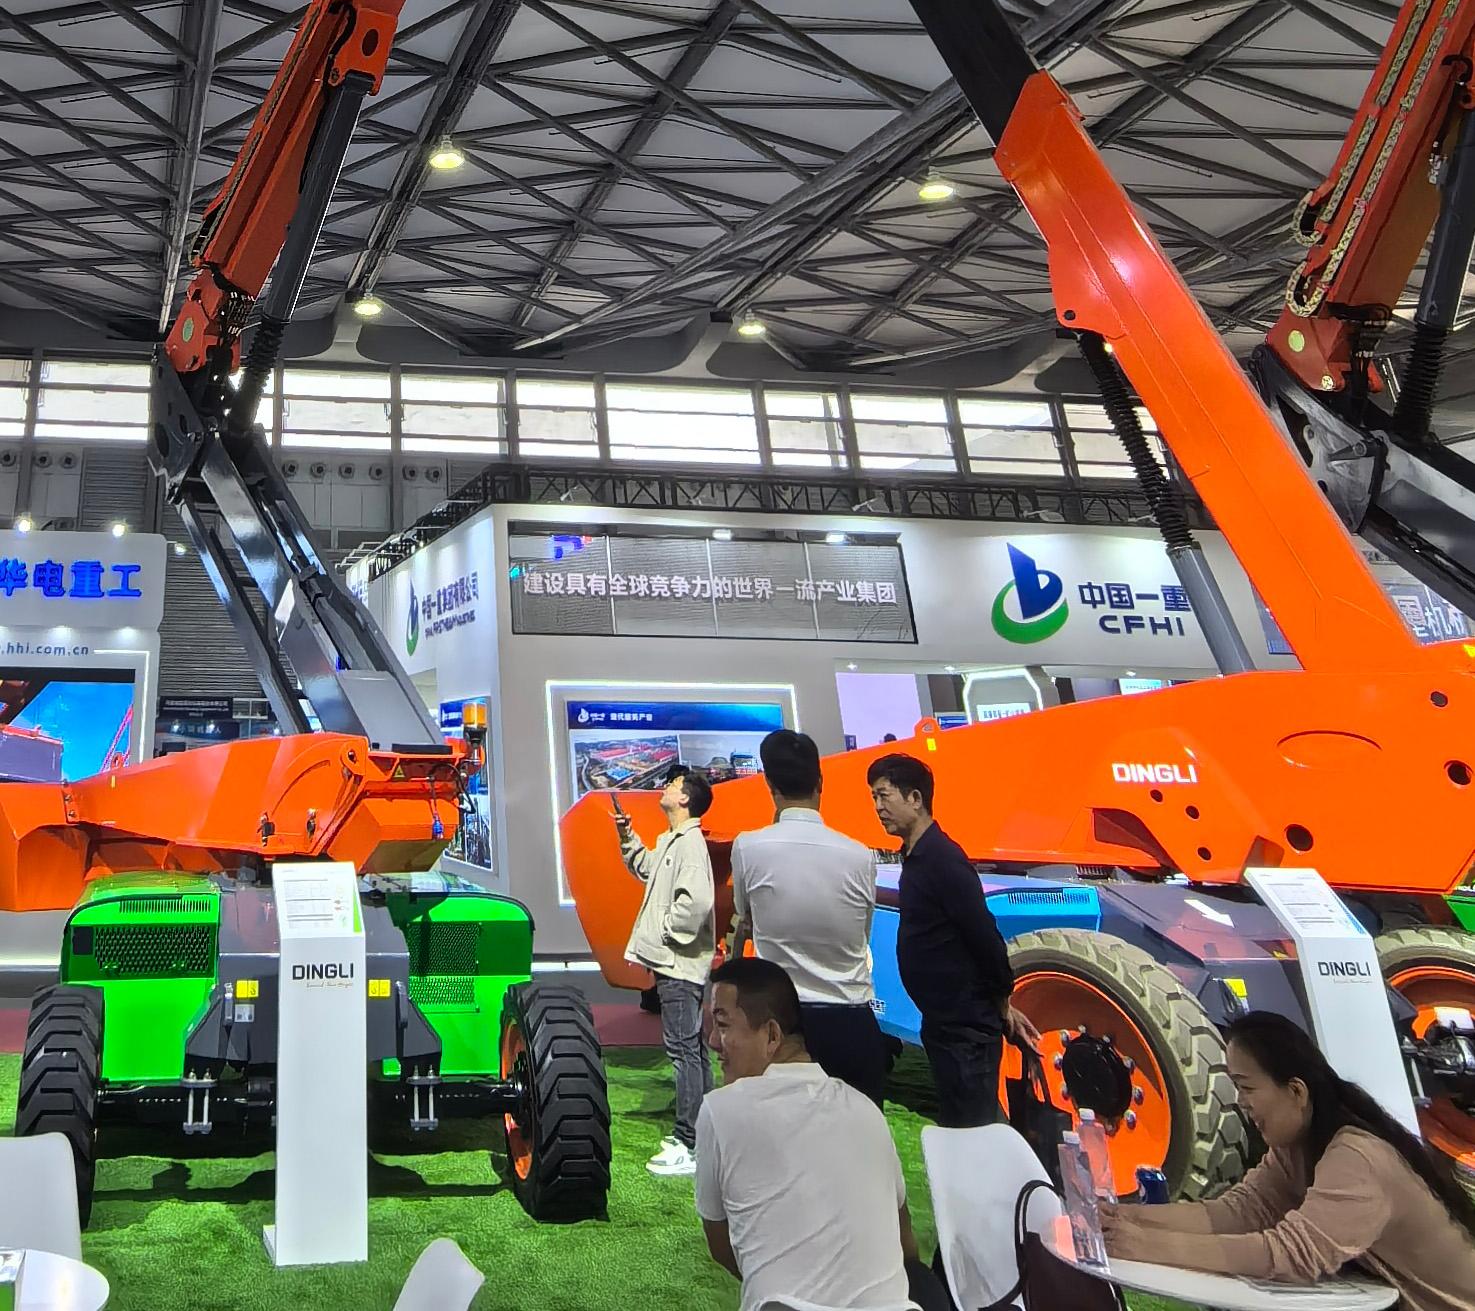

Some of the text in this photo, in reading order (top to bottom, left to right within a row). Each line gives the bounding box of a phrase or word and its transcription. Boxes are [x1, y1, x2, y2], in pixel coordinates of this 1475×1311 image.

[0, 558, 142, 598] 华电重工
[523, 572, 898, 605] 建设具有全球竞争力的世界一流产业集团
[1078, 582, 1191, 611] 中国一重
[1099, 615, 1185, 636] CFHI
[1111, 762, 1198, 783] DINGLI
[292, 963, 354, 980] DINGLI
[1318, 961, 1371, 976] DINGLI
